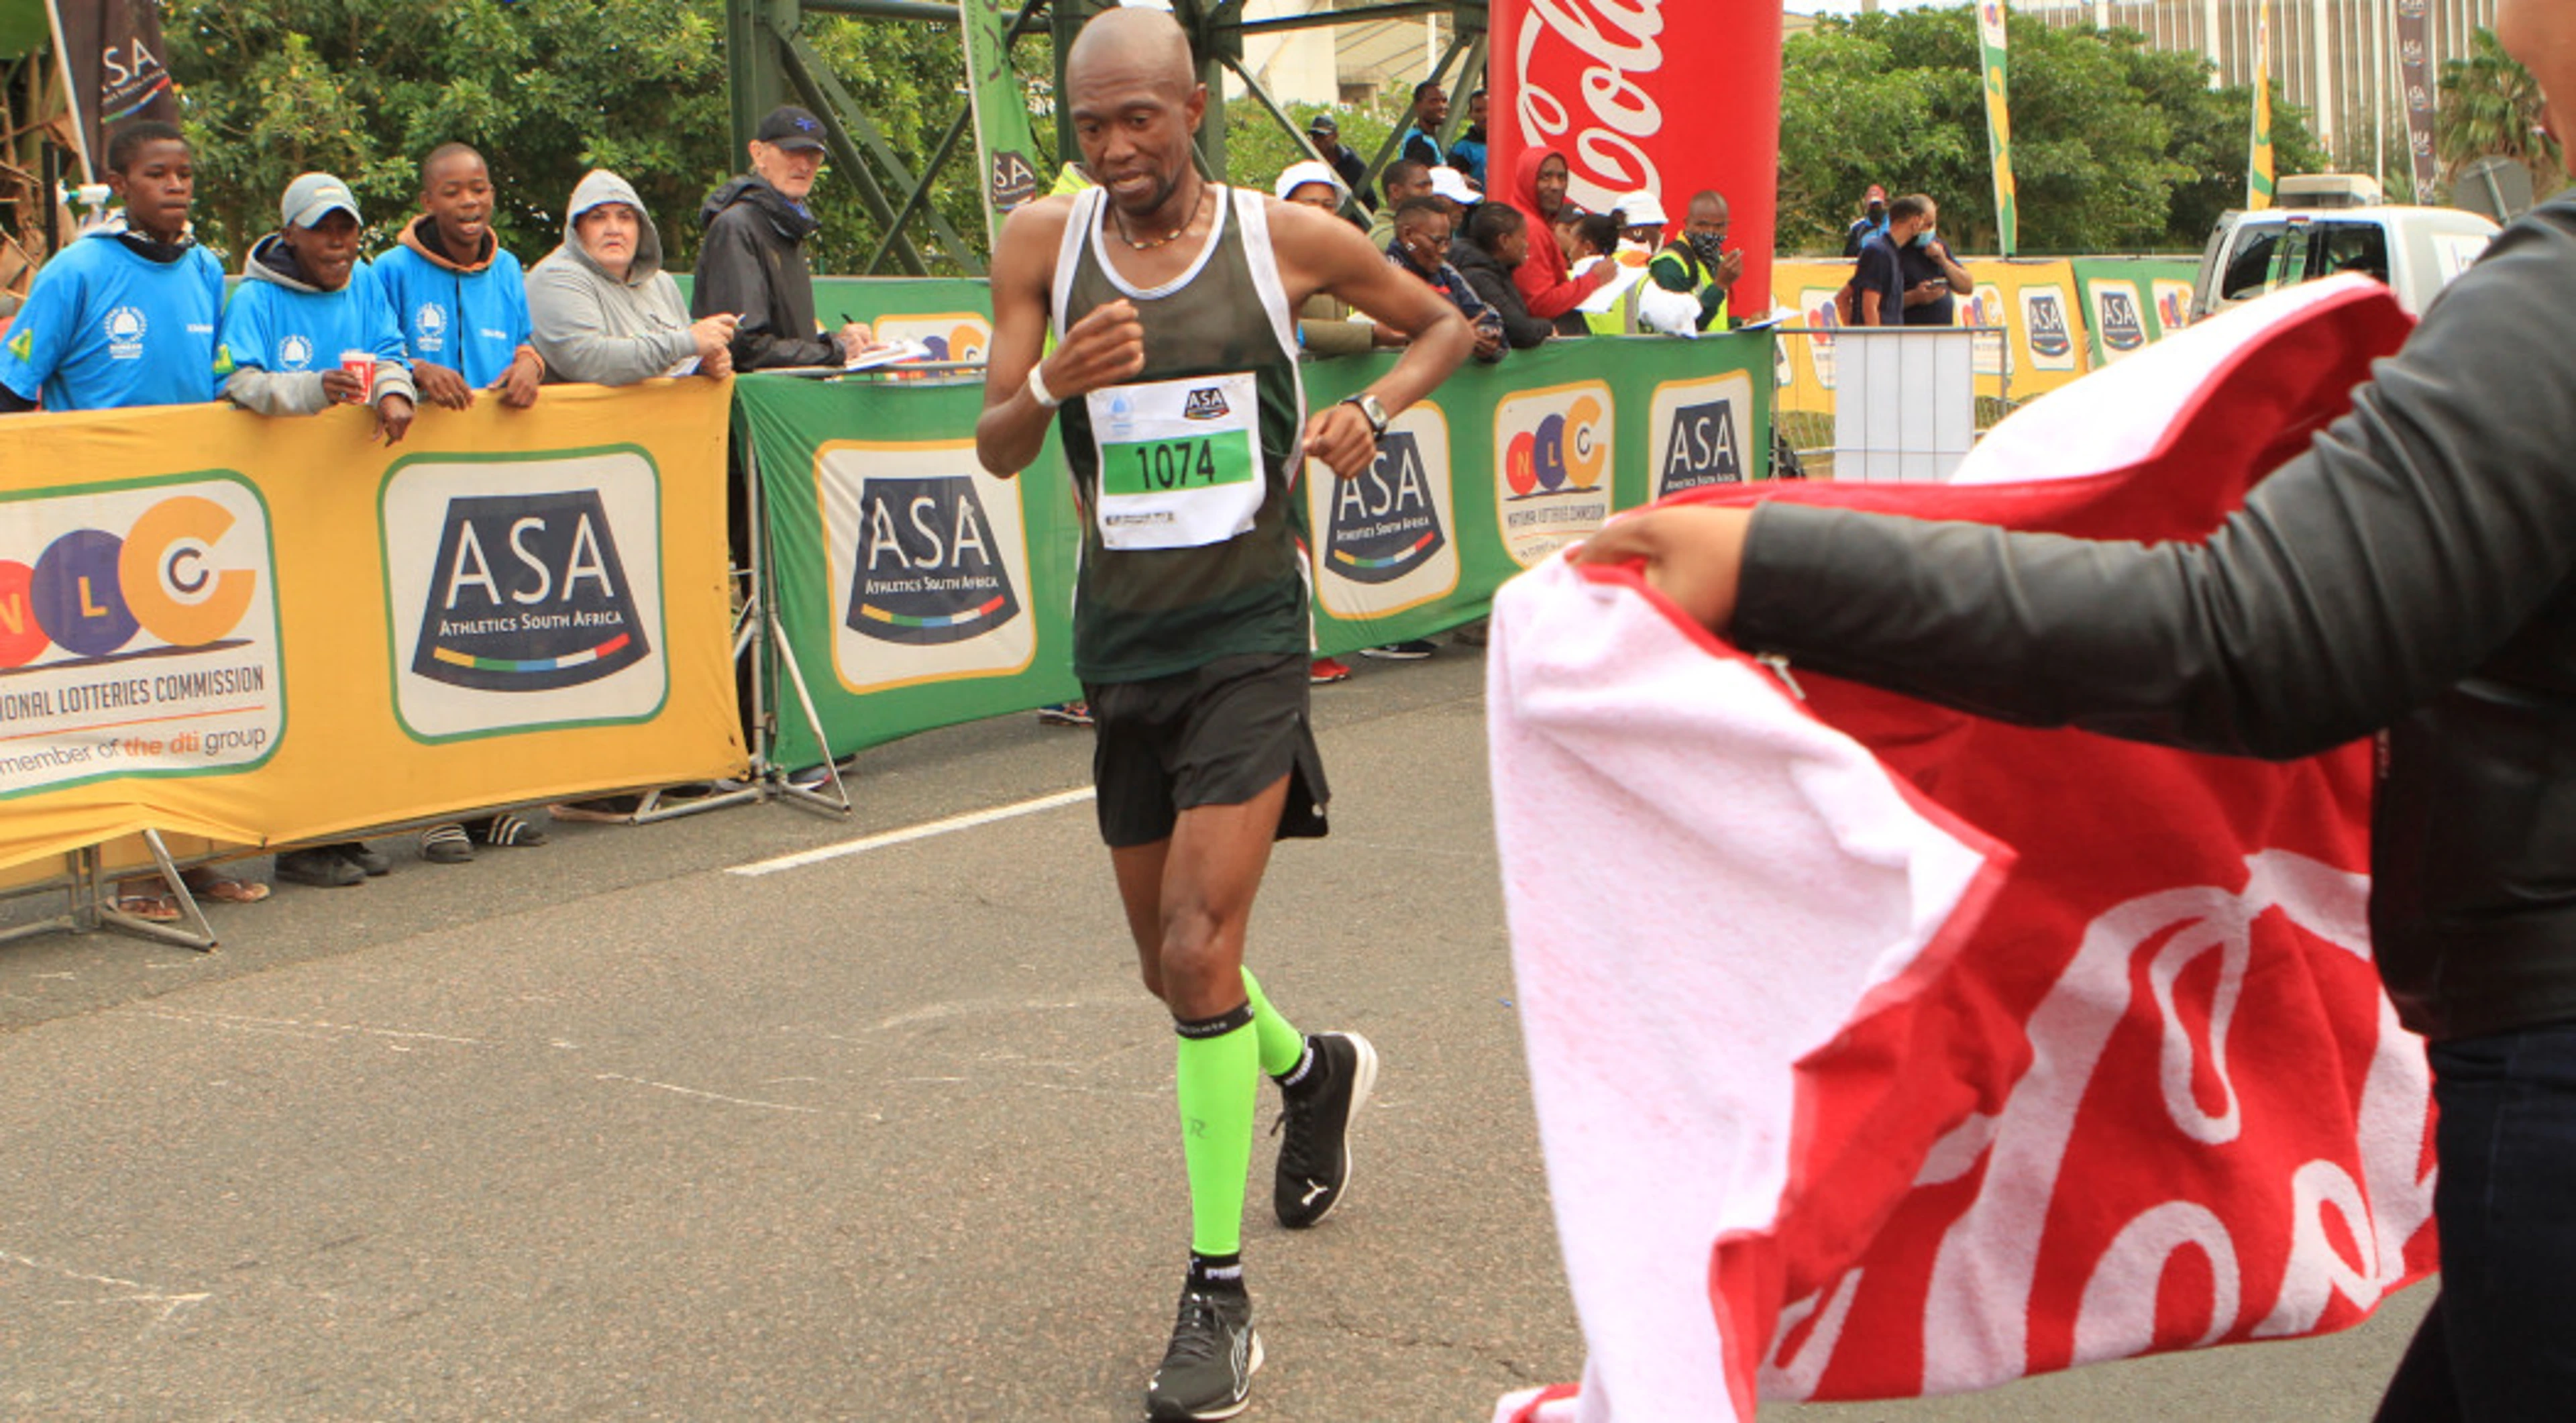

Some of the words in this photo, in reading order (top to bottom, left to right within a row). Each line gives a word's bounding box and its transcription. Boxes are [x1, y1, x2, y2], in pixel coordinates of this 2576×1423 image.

[101, 36, 160, 93] SA
[2030, 302, 2062, 331] ASA
[2104, 299, 2135, 326] ASA
[1189, 389, 1224, 408] ASA
[1136, 439, 1215, 490] 1074
[1670, 413, 1733, 474] ASA
[1338, 448, 1424, 521] ASA
[867, 494, 991, 570] ASA
[445, 512, 615, 610] ASA
[438, 618, 517, 637] ATHLETICS
[521, 612, 570, 630] SOUTH
[573, 609, 625, 627] AFRICA
[58, 679, 150, 715] LOTTERIES
[155, 664, 264, 702] COMMISSION
[0, 745, 92, 776] member
[97, 737, 119, 759] of
[123, 735, 163, 757] the
[170, 730, 200, 754] dti
[205, 727, 266, 757] group
